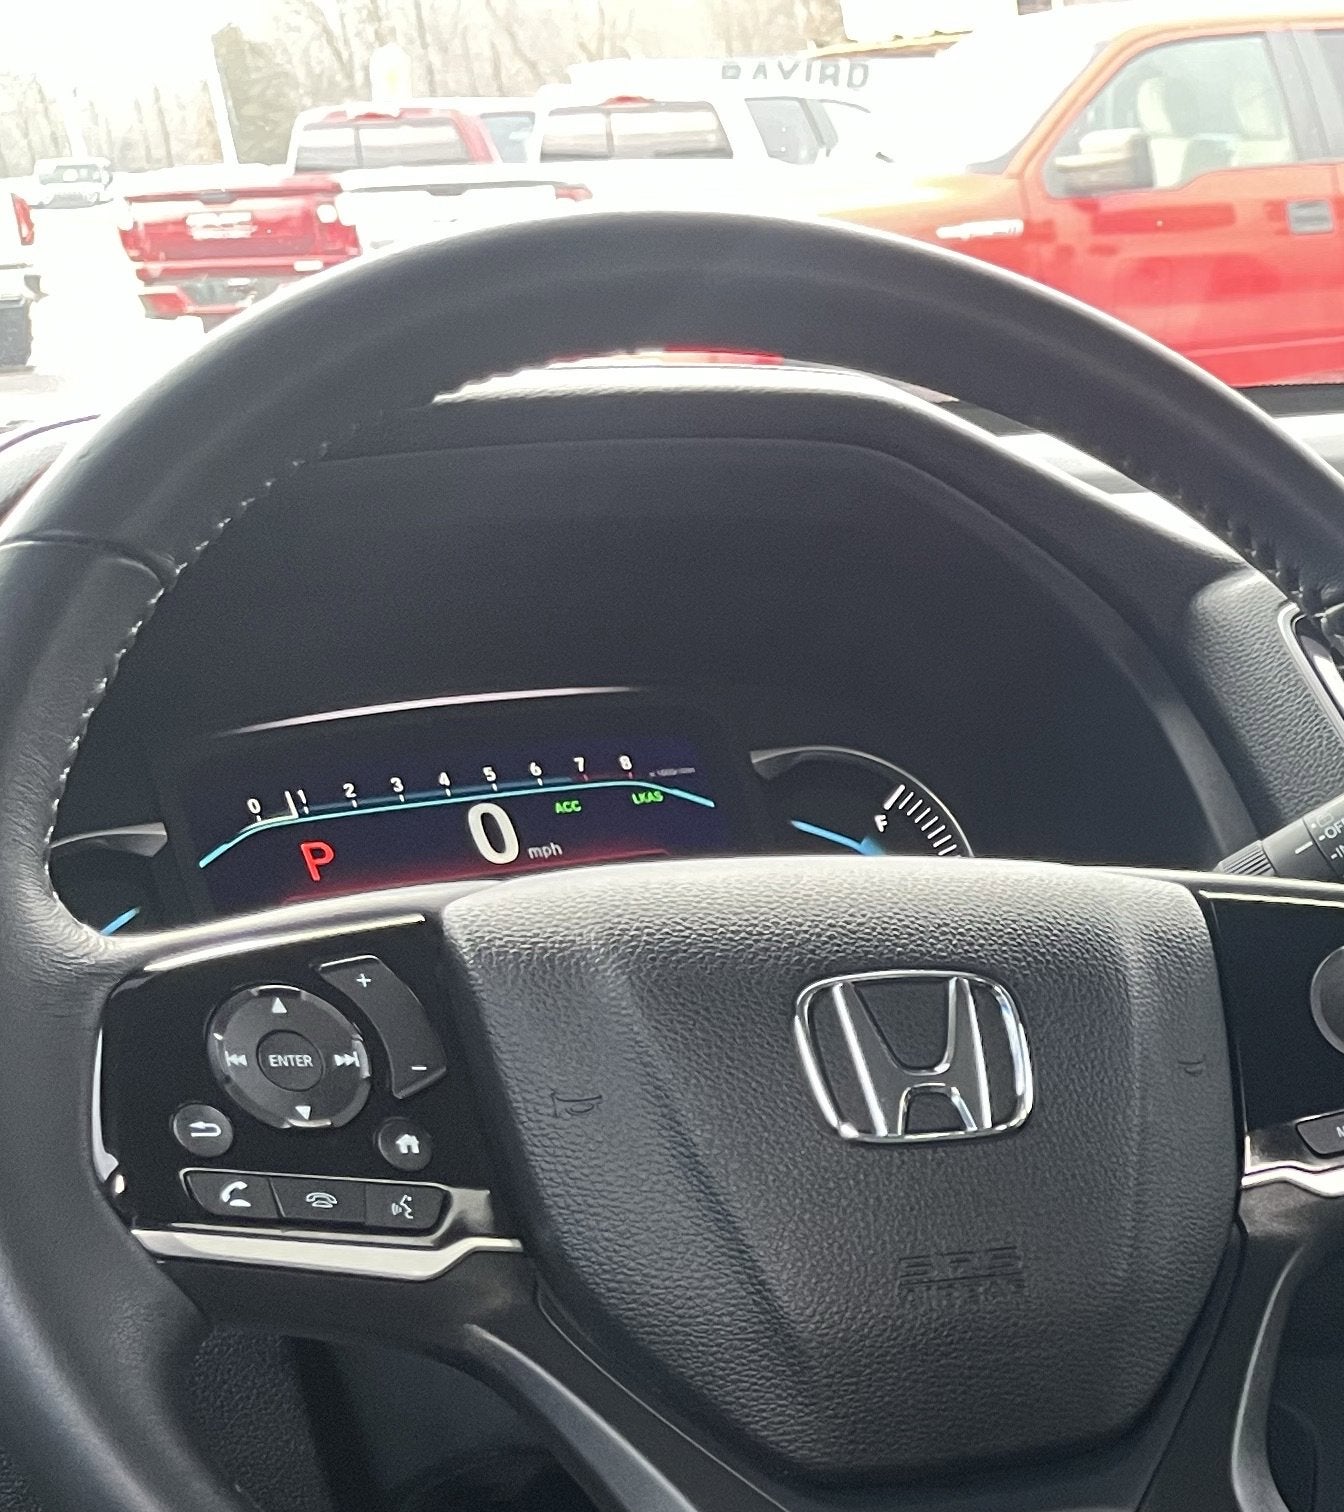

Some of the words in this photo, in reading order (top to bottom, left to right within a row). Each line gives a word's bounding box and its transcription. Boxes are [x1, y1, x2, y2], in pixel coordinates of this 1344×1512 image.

[246, 798, 262, 814] 0
[297, 789, 307, 803] 1
[342, 783, 358, 798] 2
[390, 776, 404, 793] 3
[438, 771, 451, 786] 4
[482, 766, 497, 782] 5
[529, 761, 543, 777] 6
[573, 757, 585, 772] 7
[618, 755, 632, 771] 8
[555, 800, 582, 814] ACC
[631, 791, 664, 805] LKAS
[874, 814, 888, 833] F
[468, 802, 520, 865] 0
[528, 842, 563, 861] mph
[300, 841, 336, 881] P
[268, 1053, 313, 1068] ENTER
